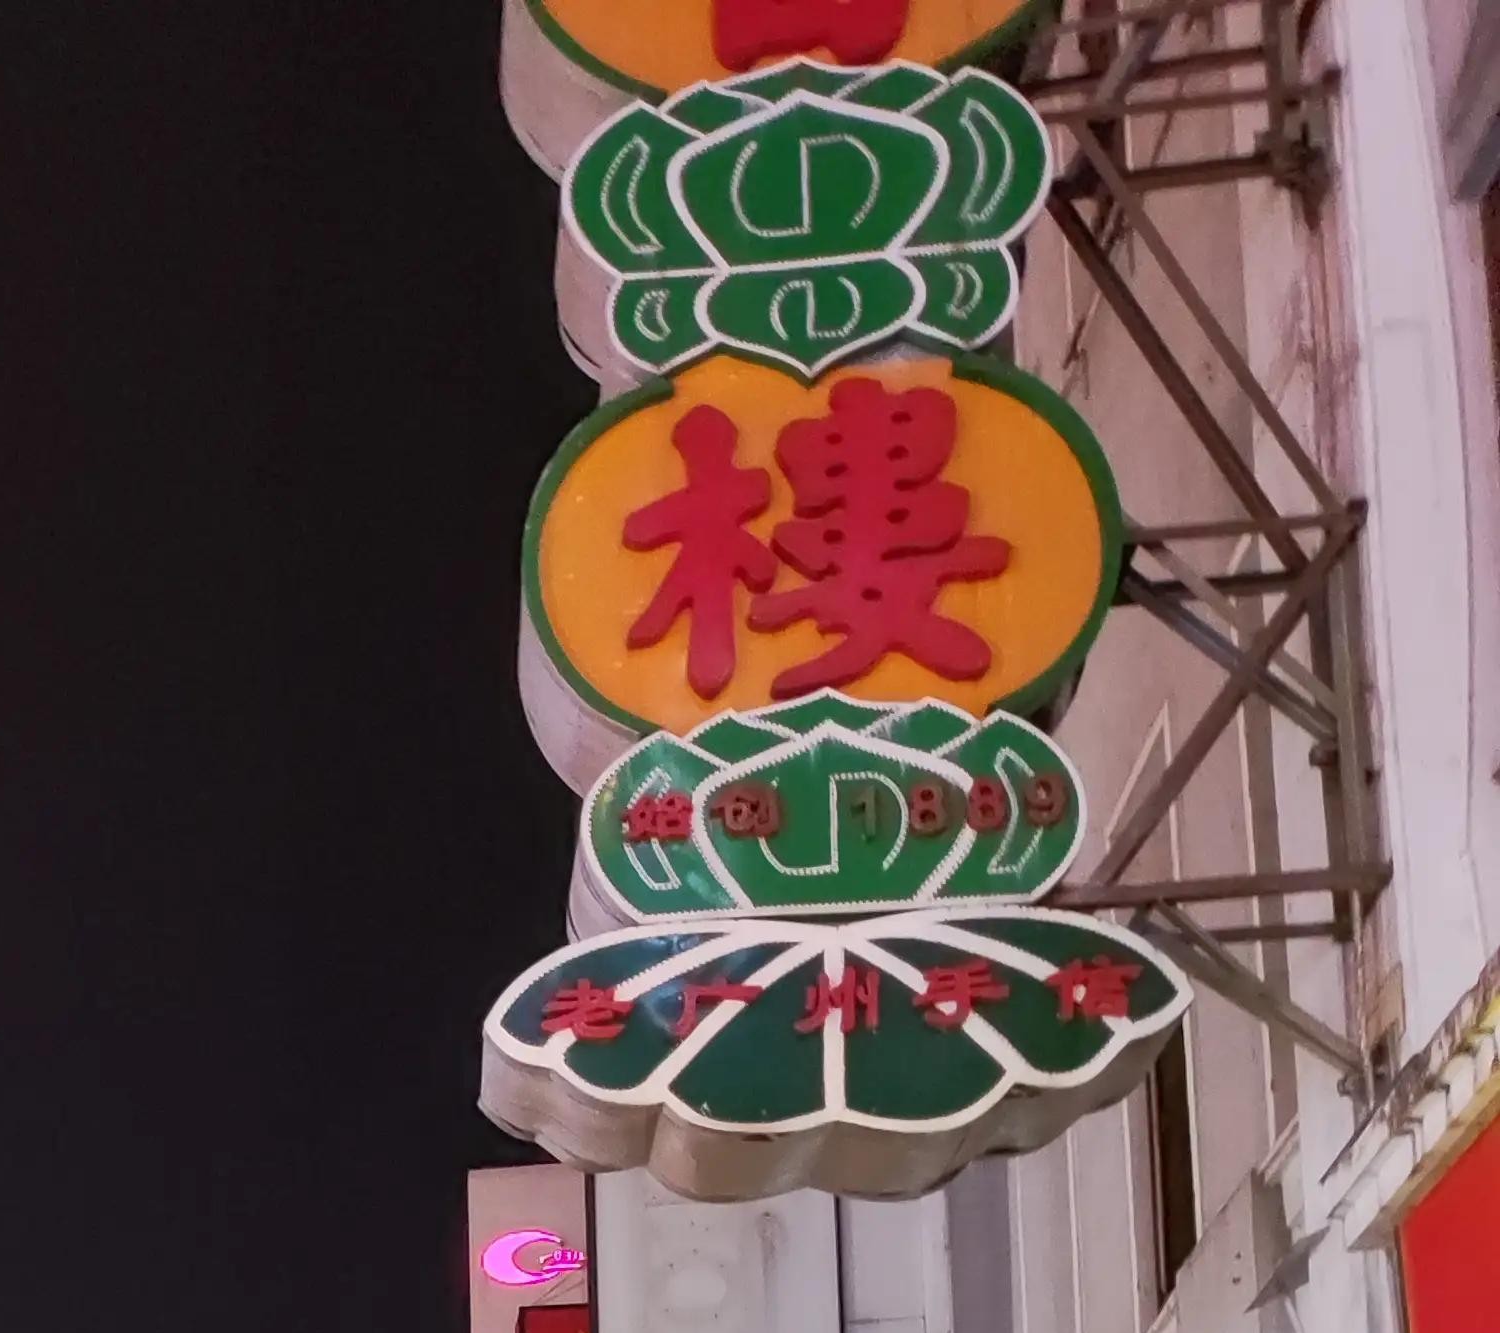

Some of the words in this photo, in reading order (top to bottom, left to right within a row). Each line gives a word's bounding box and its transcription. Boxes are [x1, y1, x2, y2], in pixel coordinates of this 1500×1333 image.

[622, 784, 784, 846] 始创
[850, 773, 1067, 838] 1889
[541, 952, 1142, 1042] 老广州手信
